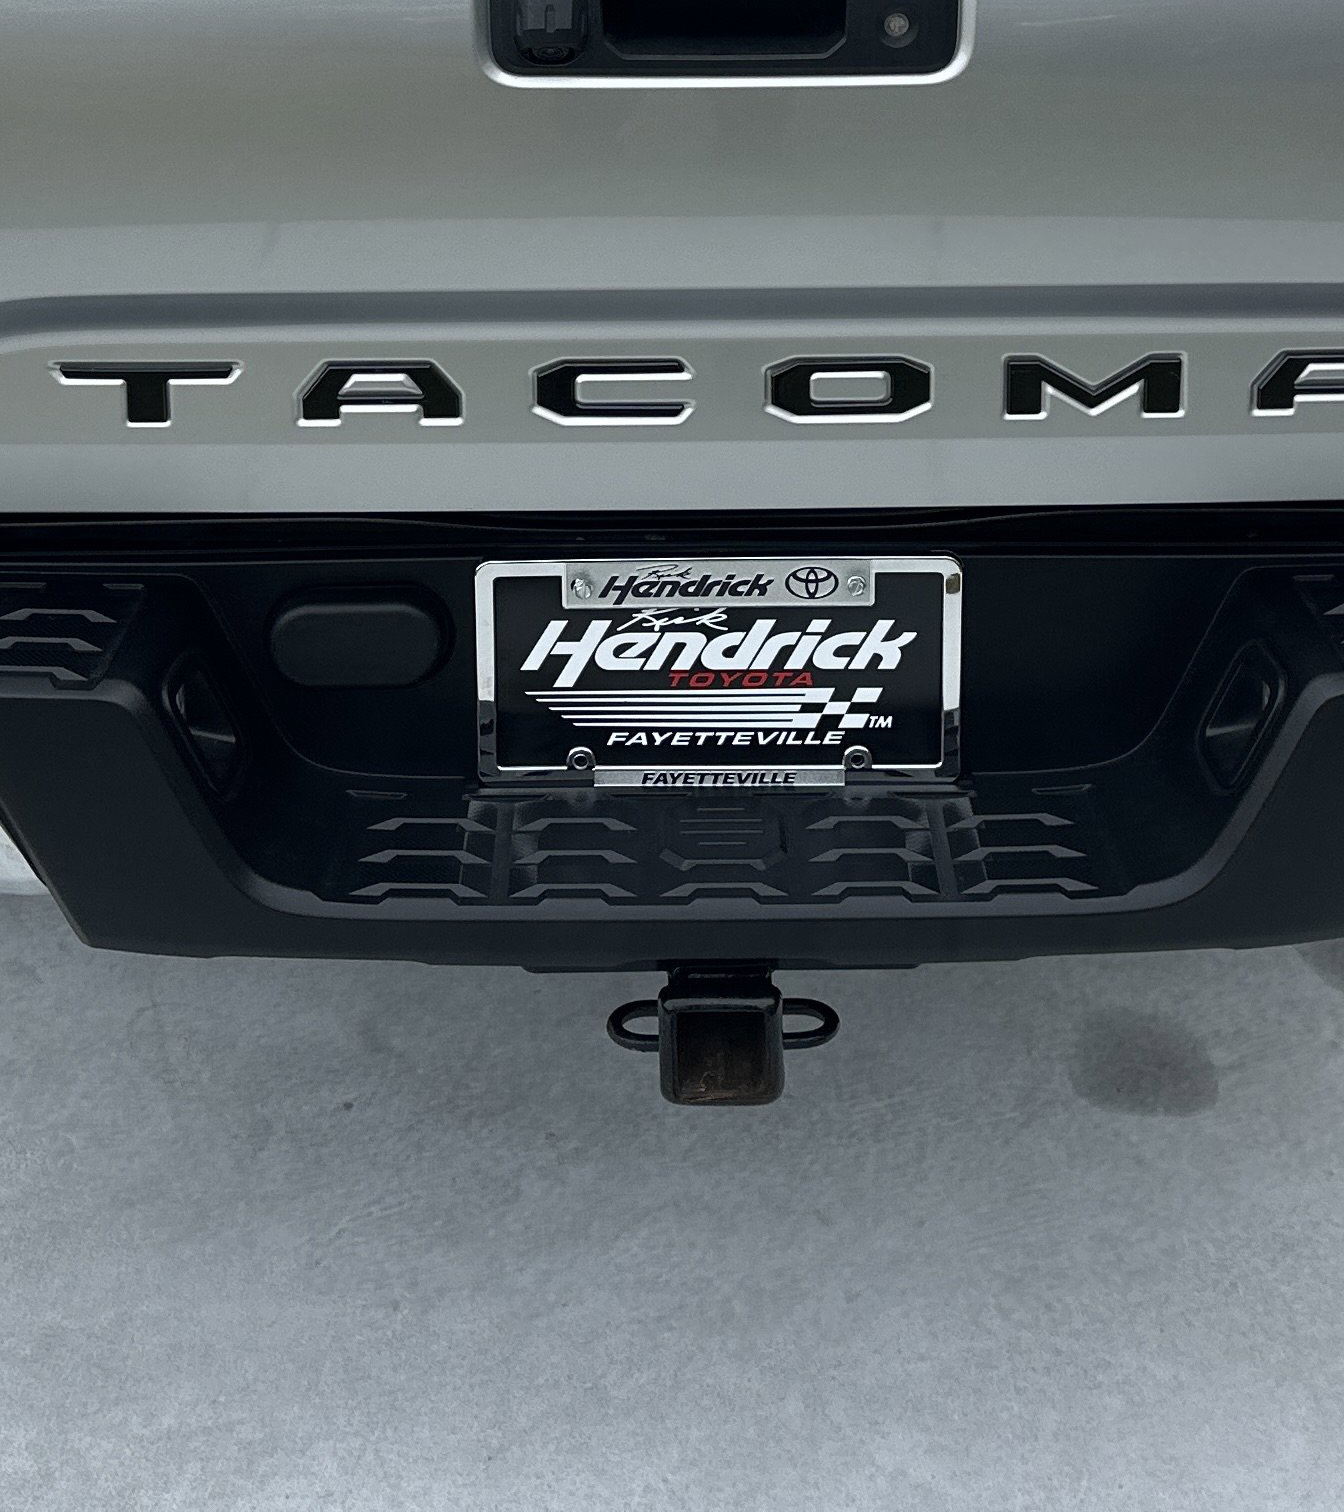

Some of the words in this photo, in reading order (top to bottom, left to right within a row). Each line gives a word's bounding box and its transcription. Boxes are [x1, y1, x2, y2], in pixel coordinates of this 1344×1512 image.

[598, 574, 774, 606] Hendrick
[519, 619, 918, 688] Hendrick
[667, 671, 814, 687] TOYOTA
[868, 716, 893, 729] TM
[606, 731, 846, 747] FAYETTEVILLE
[641, 771, 797, 786] FAYETTEVILLE
